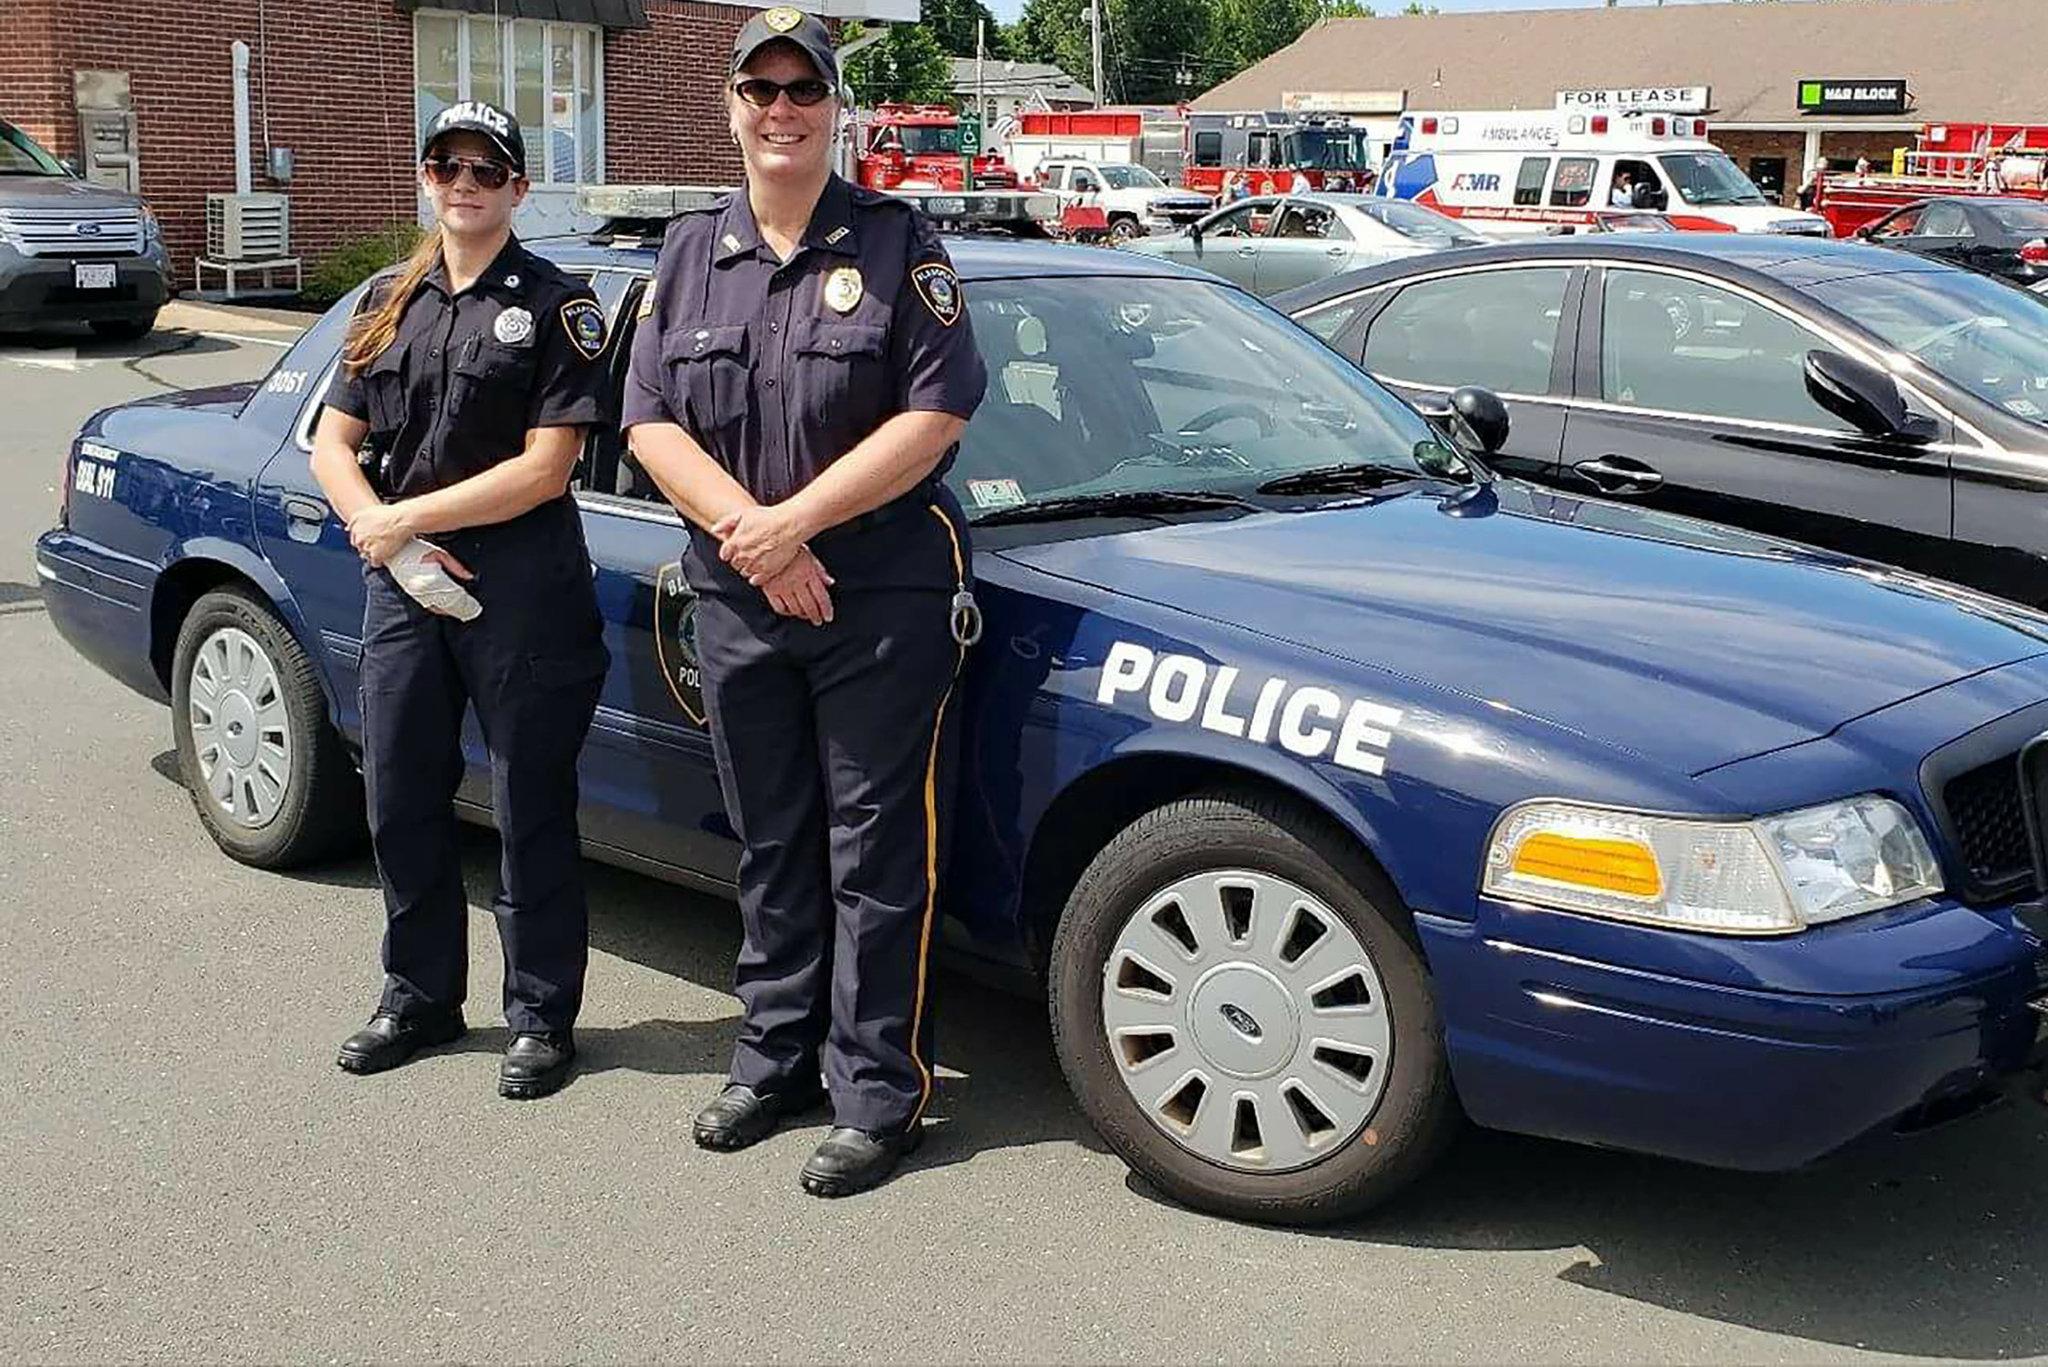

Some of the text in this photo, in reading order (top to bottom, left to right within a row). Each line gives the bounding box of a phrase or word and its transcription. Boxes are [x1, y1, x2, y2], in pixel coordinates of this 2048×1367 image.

[1564, 89, 1693, 104] FOR LEASE
[1853, 88, 1897, 100] BLOCK
[436, 101, 508, 137] POLICE
[1482, 127, 1551, 141] AMBULANCE
[1451, 173, 1500, 191] AMR
[1096, 640, 1404, 777] POLICE
